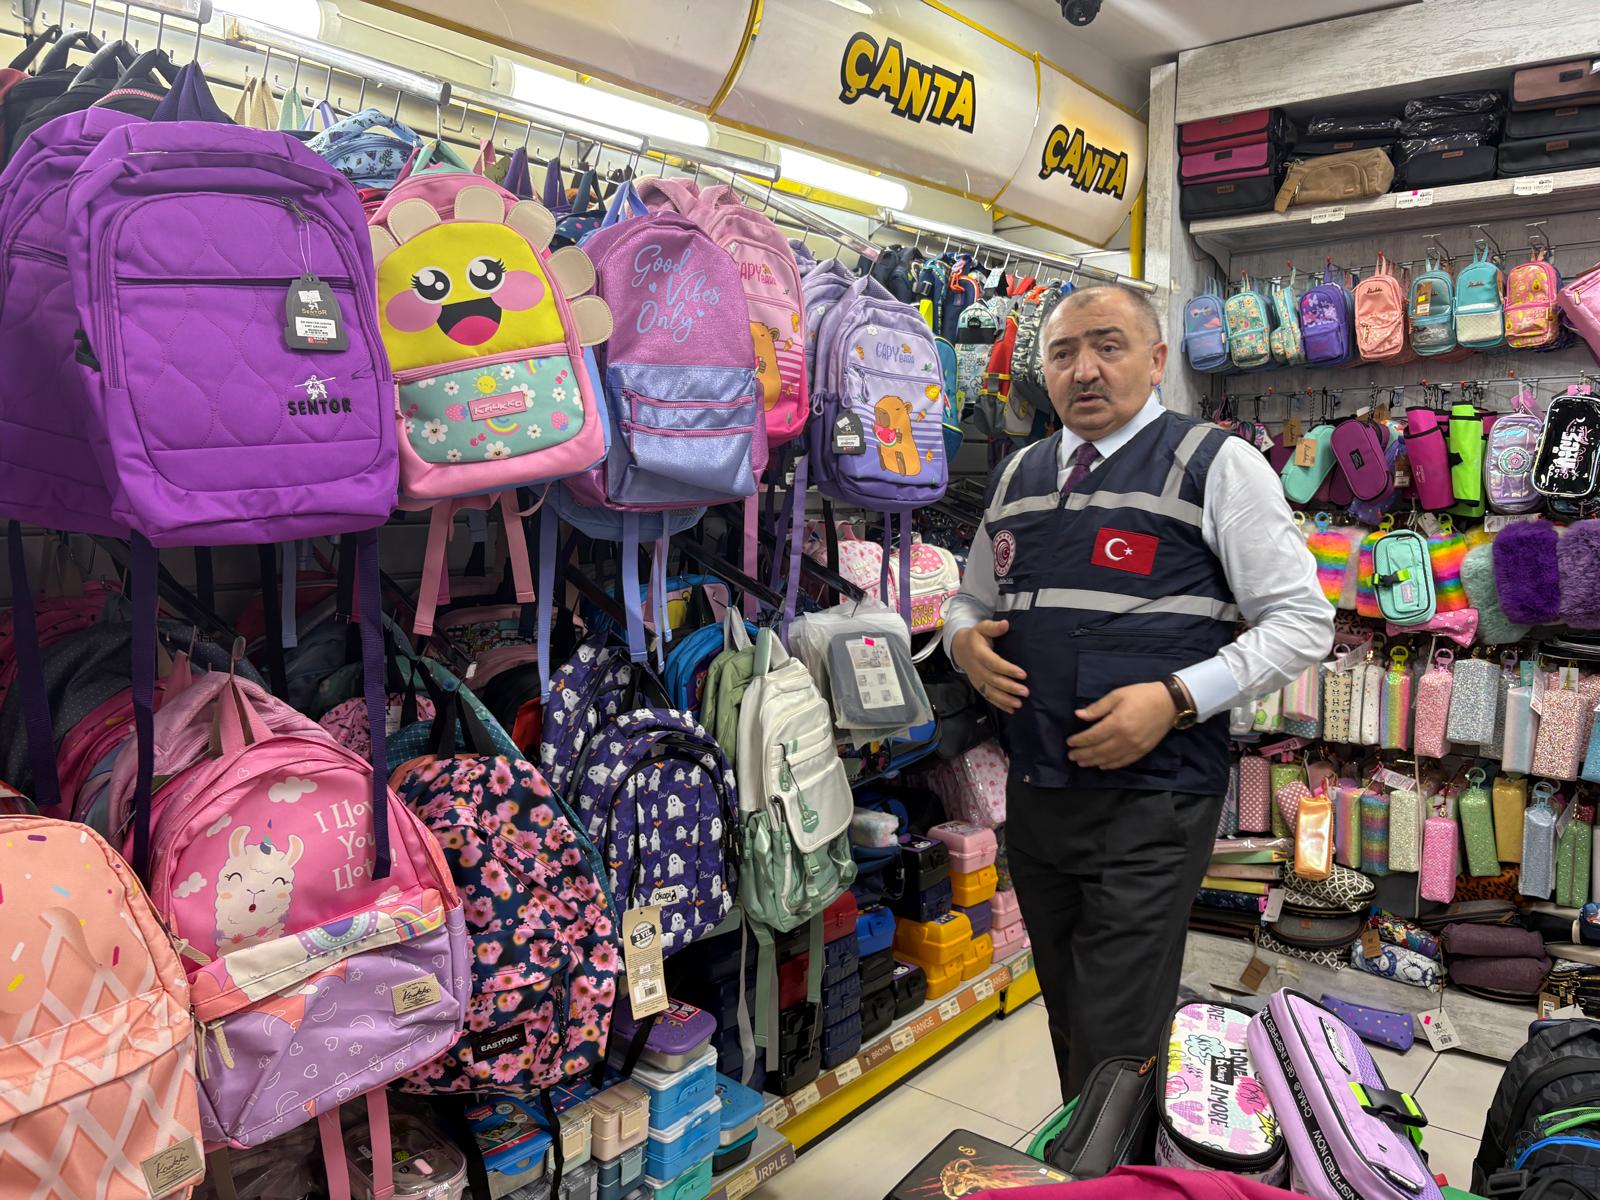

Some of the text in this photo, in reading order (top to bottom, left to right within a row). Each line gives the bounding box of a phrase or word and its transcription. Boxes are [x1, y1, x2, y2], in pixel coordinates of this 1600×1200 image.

[839, 32, 976, 134] ÇANTA
[1039, 124, 1128, 200] ÇANTA
[632, 244, 691, 287] Good
[666, 269, 721, 306] Vibes
[636, 300, 694, 343] Only
[287, 398, 352, 416] SENTOR
[912, 604, 934, 616] TTLE
[313, 799, 374, 833] I Llo
[337, 830, 376, 860] You
[992, 969, 1009, 988] ANGE
[911, 1017, 936, 1035] RANGE
[1265, 1019, 1288, 1060] INSPIRED
[480, 1033, 520, 1052] EASTPAK
[871, 1043, 892, 1060] BROWN
[1229, 1048, 1249, 1077] LOVE
[1283, 1059, 1296, 1078] GET
[1207, 1084, 1229, 1128] AMORE
[758, 1153, 788, 1181] RPLE
[1312, 1130, 1360, 1200] NSPIRED NOW
